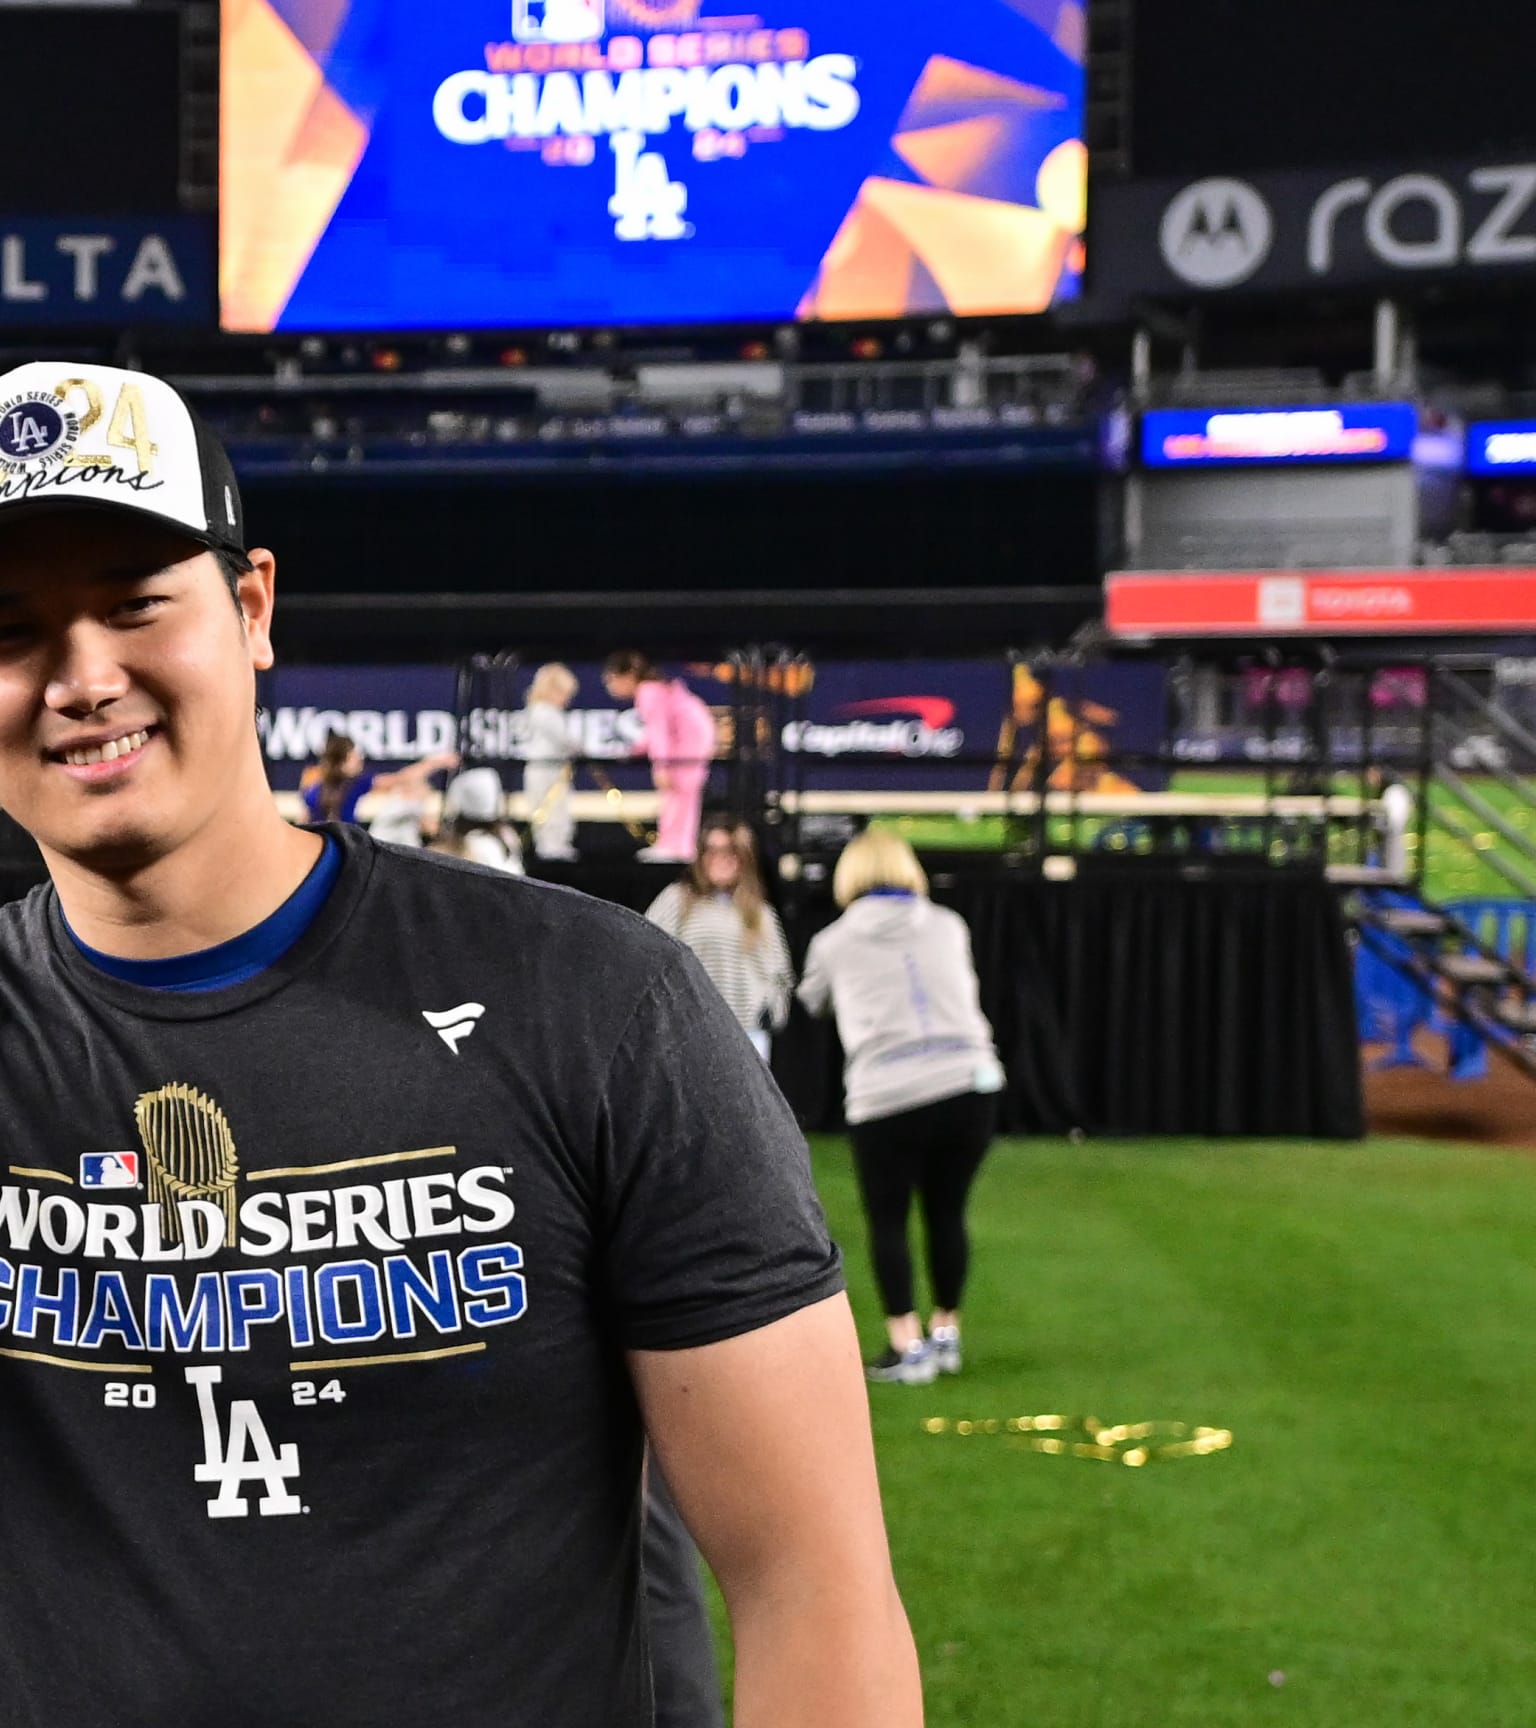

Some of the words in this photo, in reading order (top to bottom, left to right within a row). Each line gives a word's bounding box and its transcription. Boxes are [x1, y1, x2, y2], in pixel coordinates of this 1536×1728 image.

[484, 35, 645, 73] WORLD
[647, 27, 810, 69] SERIES
[432, 53, 861, 145] CHAMPIONS
[607, 130, 688, 241] LA
[26, 391, 64, 408] SERIES
[8, 411, 49, 453] LA
[259, 707, 459, 761] WORLD
[240, 1166, 515, 1255] SERIES
[104, 1382, 156, 1408] 20
[291, 1379, 346, 1406] 24
[184, 1365, 301, 1518] LA
